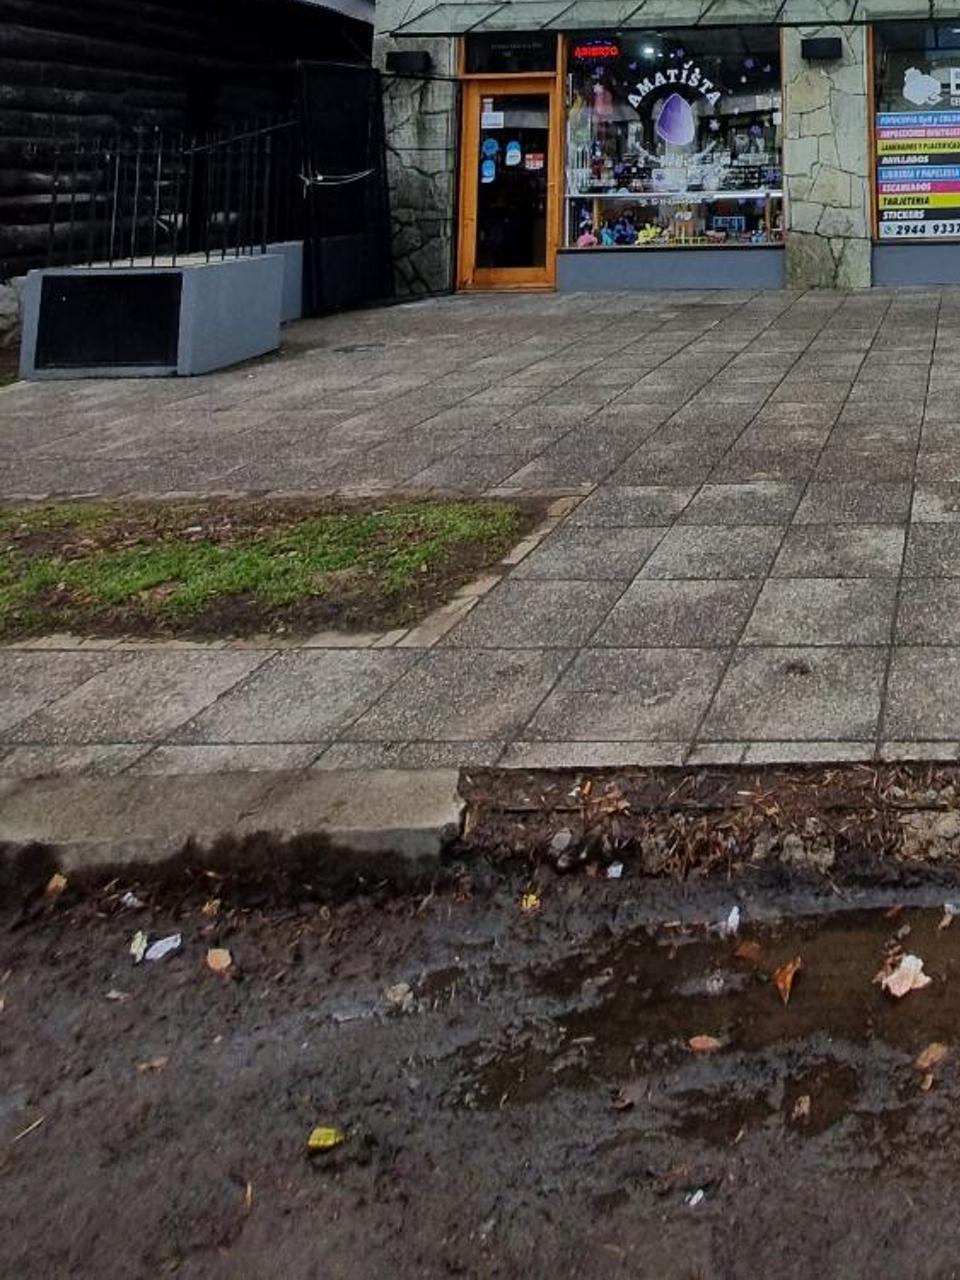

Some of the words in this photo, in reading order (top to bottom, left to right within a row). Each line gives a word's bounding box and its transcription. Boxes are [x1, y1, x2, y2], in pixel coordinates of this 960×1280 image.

[574, 46, 618, 57] ABIERTO
[883, 210, 925, 220] STICKERS
[896, 224, 926, 235] 2944
